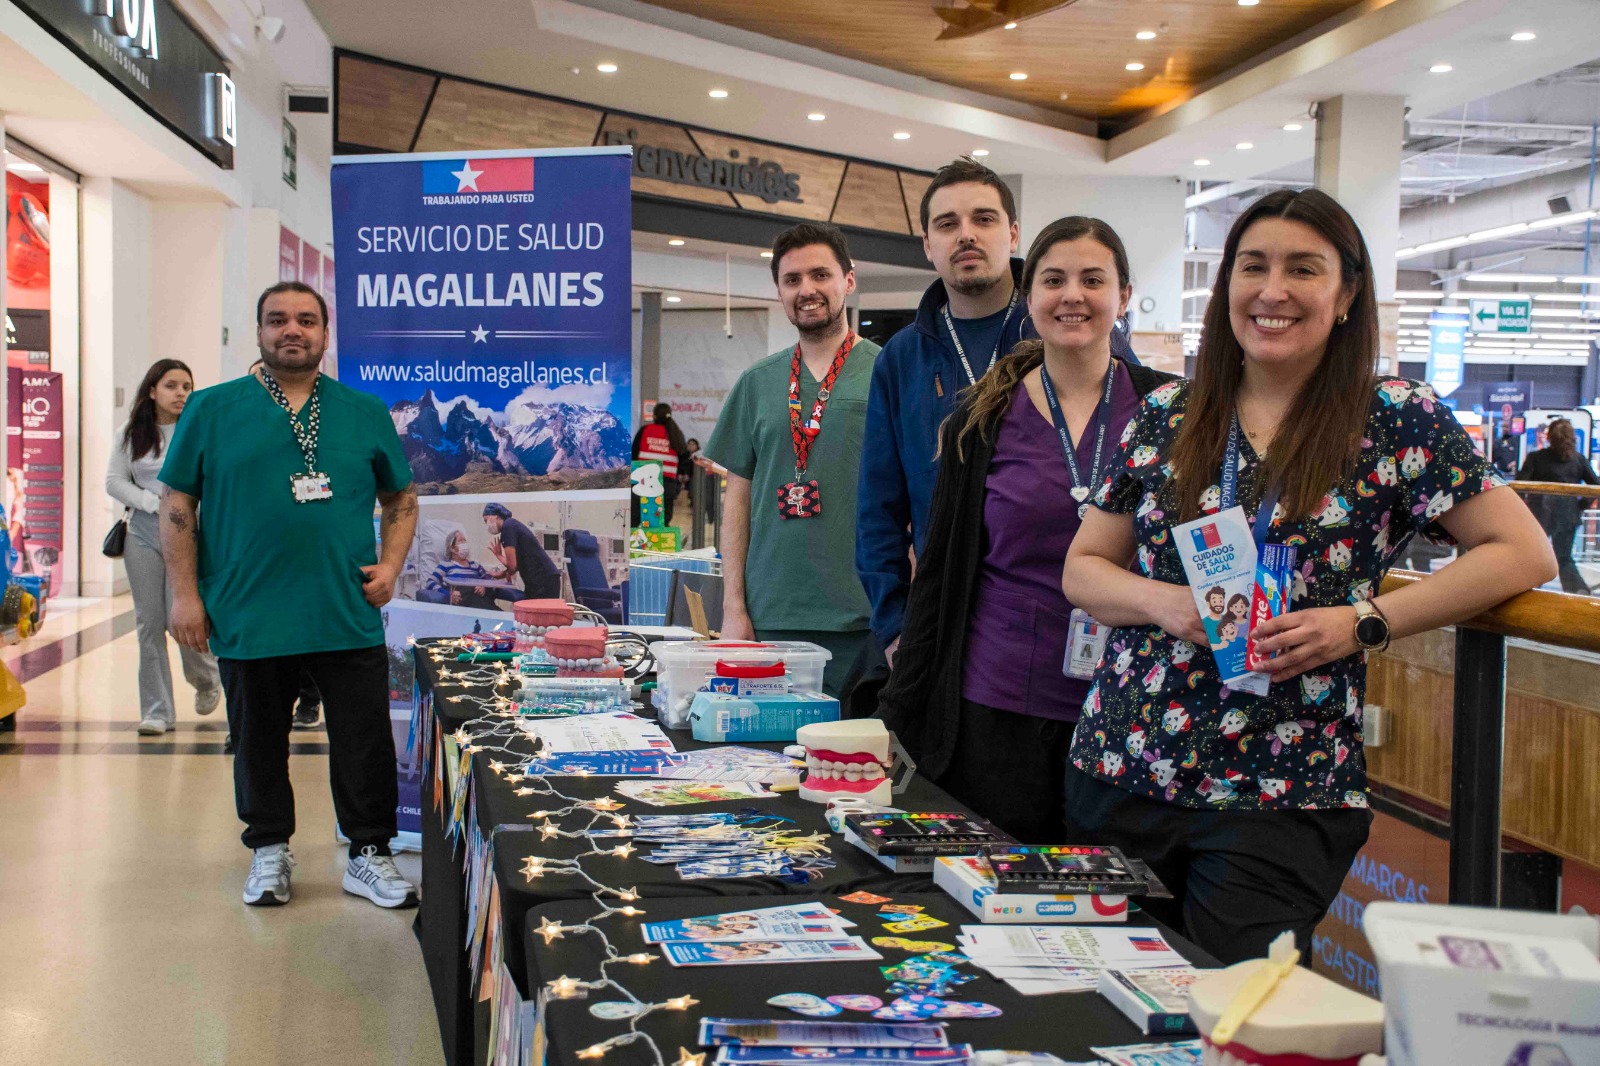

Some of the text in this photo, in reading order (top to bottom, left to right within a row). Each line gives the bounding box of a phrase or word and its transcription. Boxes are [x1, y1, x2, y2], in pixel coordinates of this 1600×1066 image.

[92, 28, 150, 90] PROFESSIONAL
[422, 192, 535, 206] TRABAJANDO PARA USTED
[357, 222, 605, 253] SERVICIO DE SALUD
[356, 271, 605, 307] MAGALLANES
[359, 360, 609, 389] www.saludmagallanes.cl
[1226, 441, 1236, 453] DE
[1223, 454, 1235, 482] SALUD
[1192, 544, 1235, 563] CUIDADOS
[1196, 553, 1235, 571] DE SALUD
[1205, 563, 1232, 577] BUCAL
[402, 806, 421, 815] CHILE
[1352, 854, 1429, 904] MARCAS
[993, 905, 1022, 914] wero
